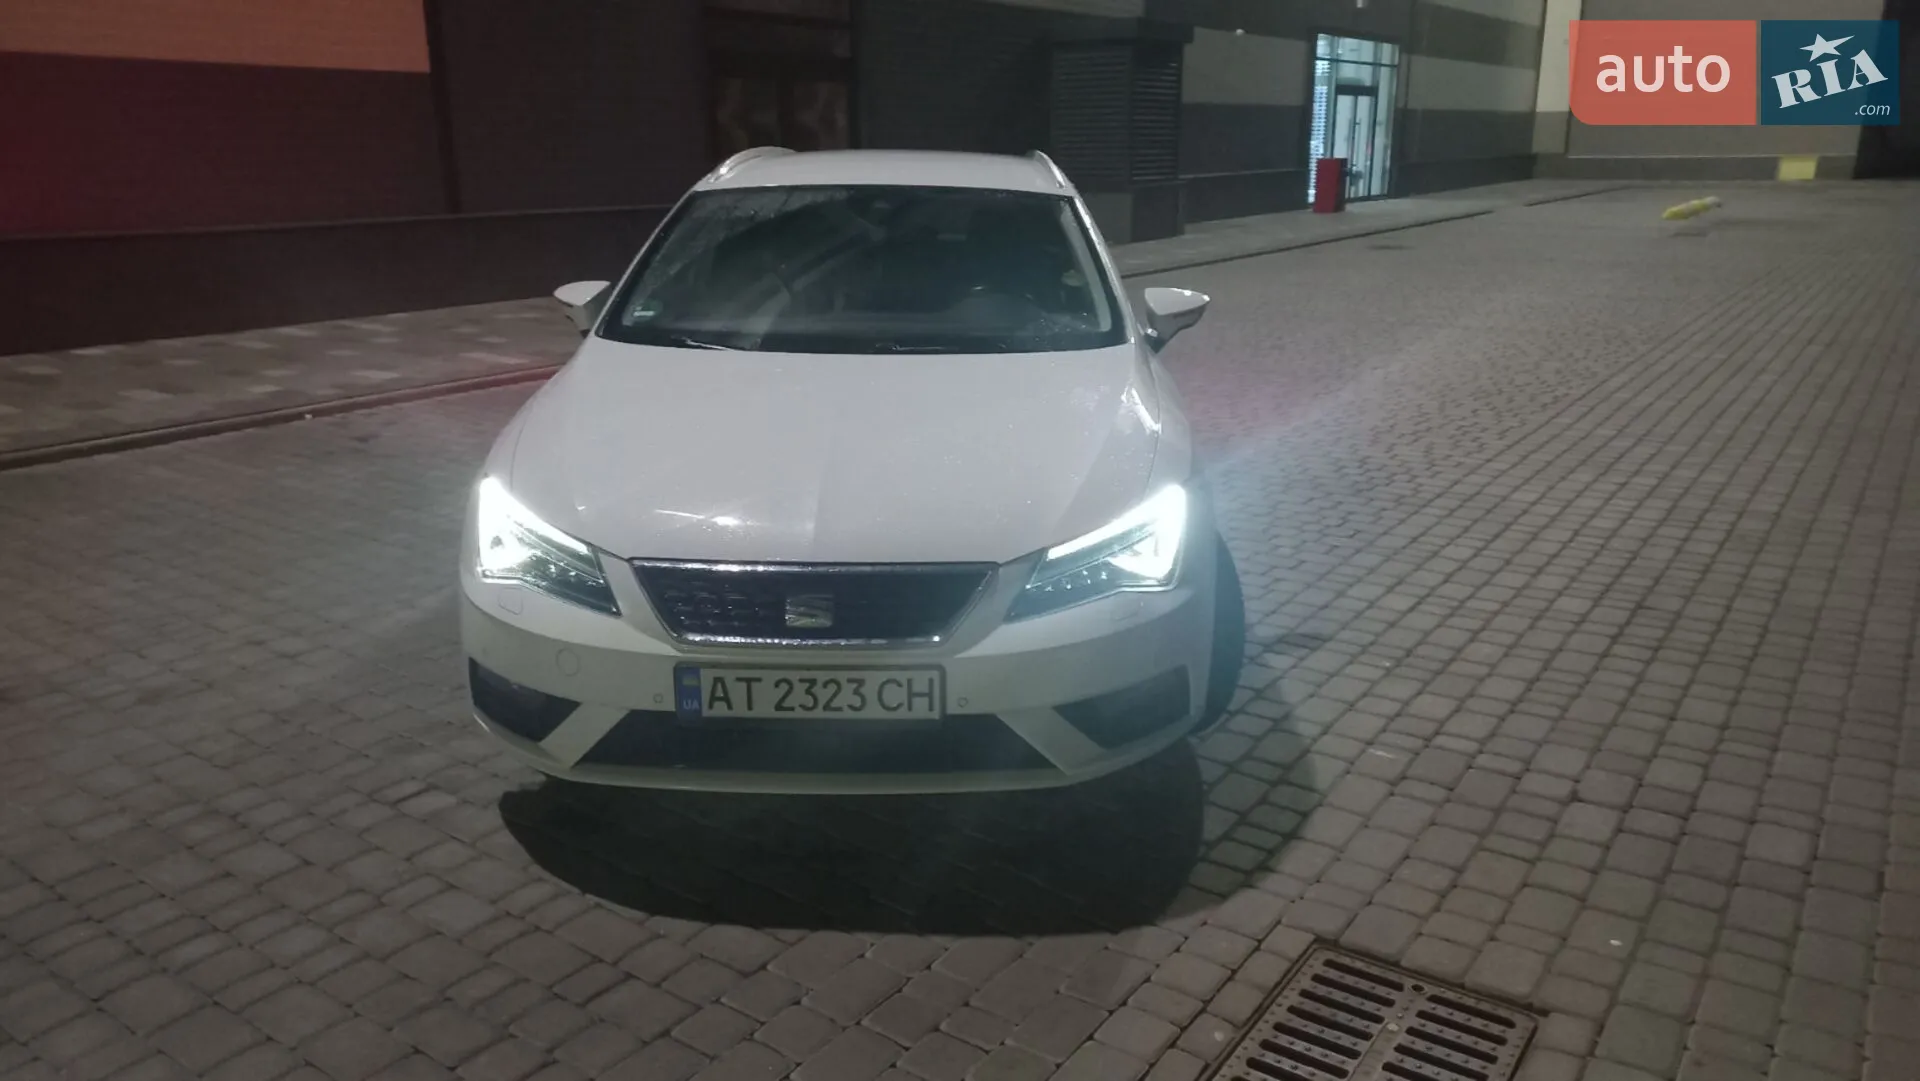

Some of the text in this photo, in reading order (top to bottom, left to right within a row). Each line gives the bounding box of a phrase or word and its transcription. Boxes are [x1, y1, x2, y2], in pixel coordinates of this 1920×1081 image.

[708, 676, 934, 712] AT 2323 CH
[683, 701, 700, 710] UA
